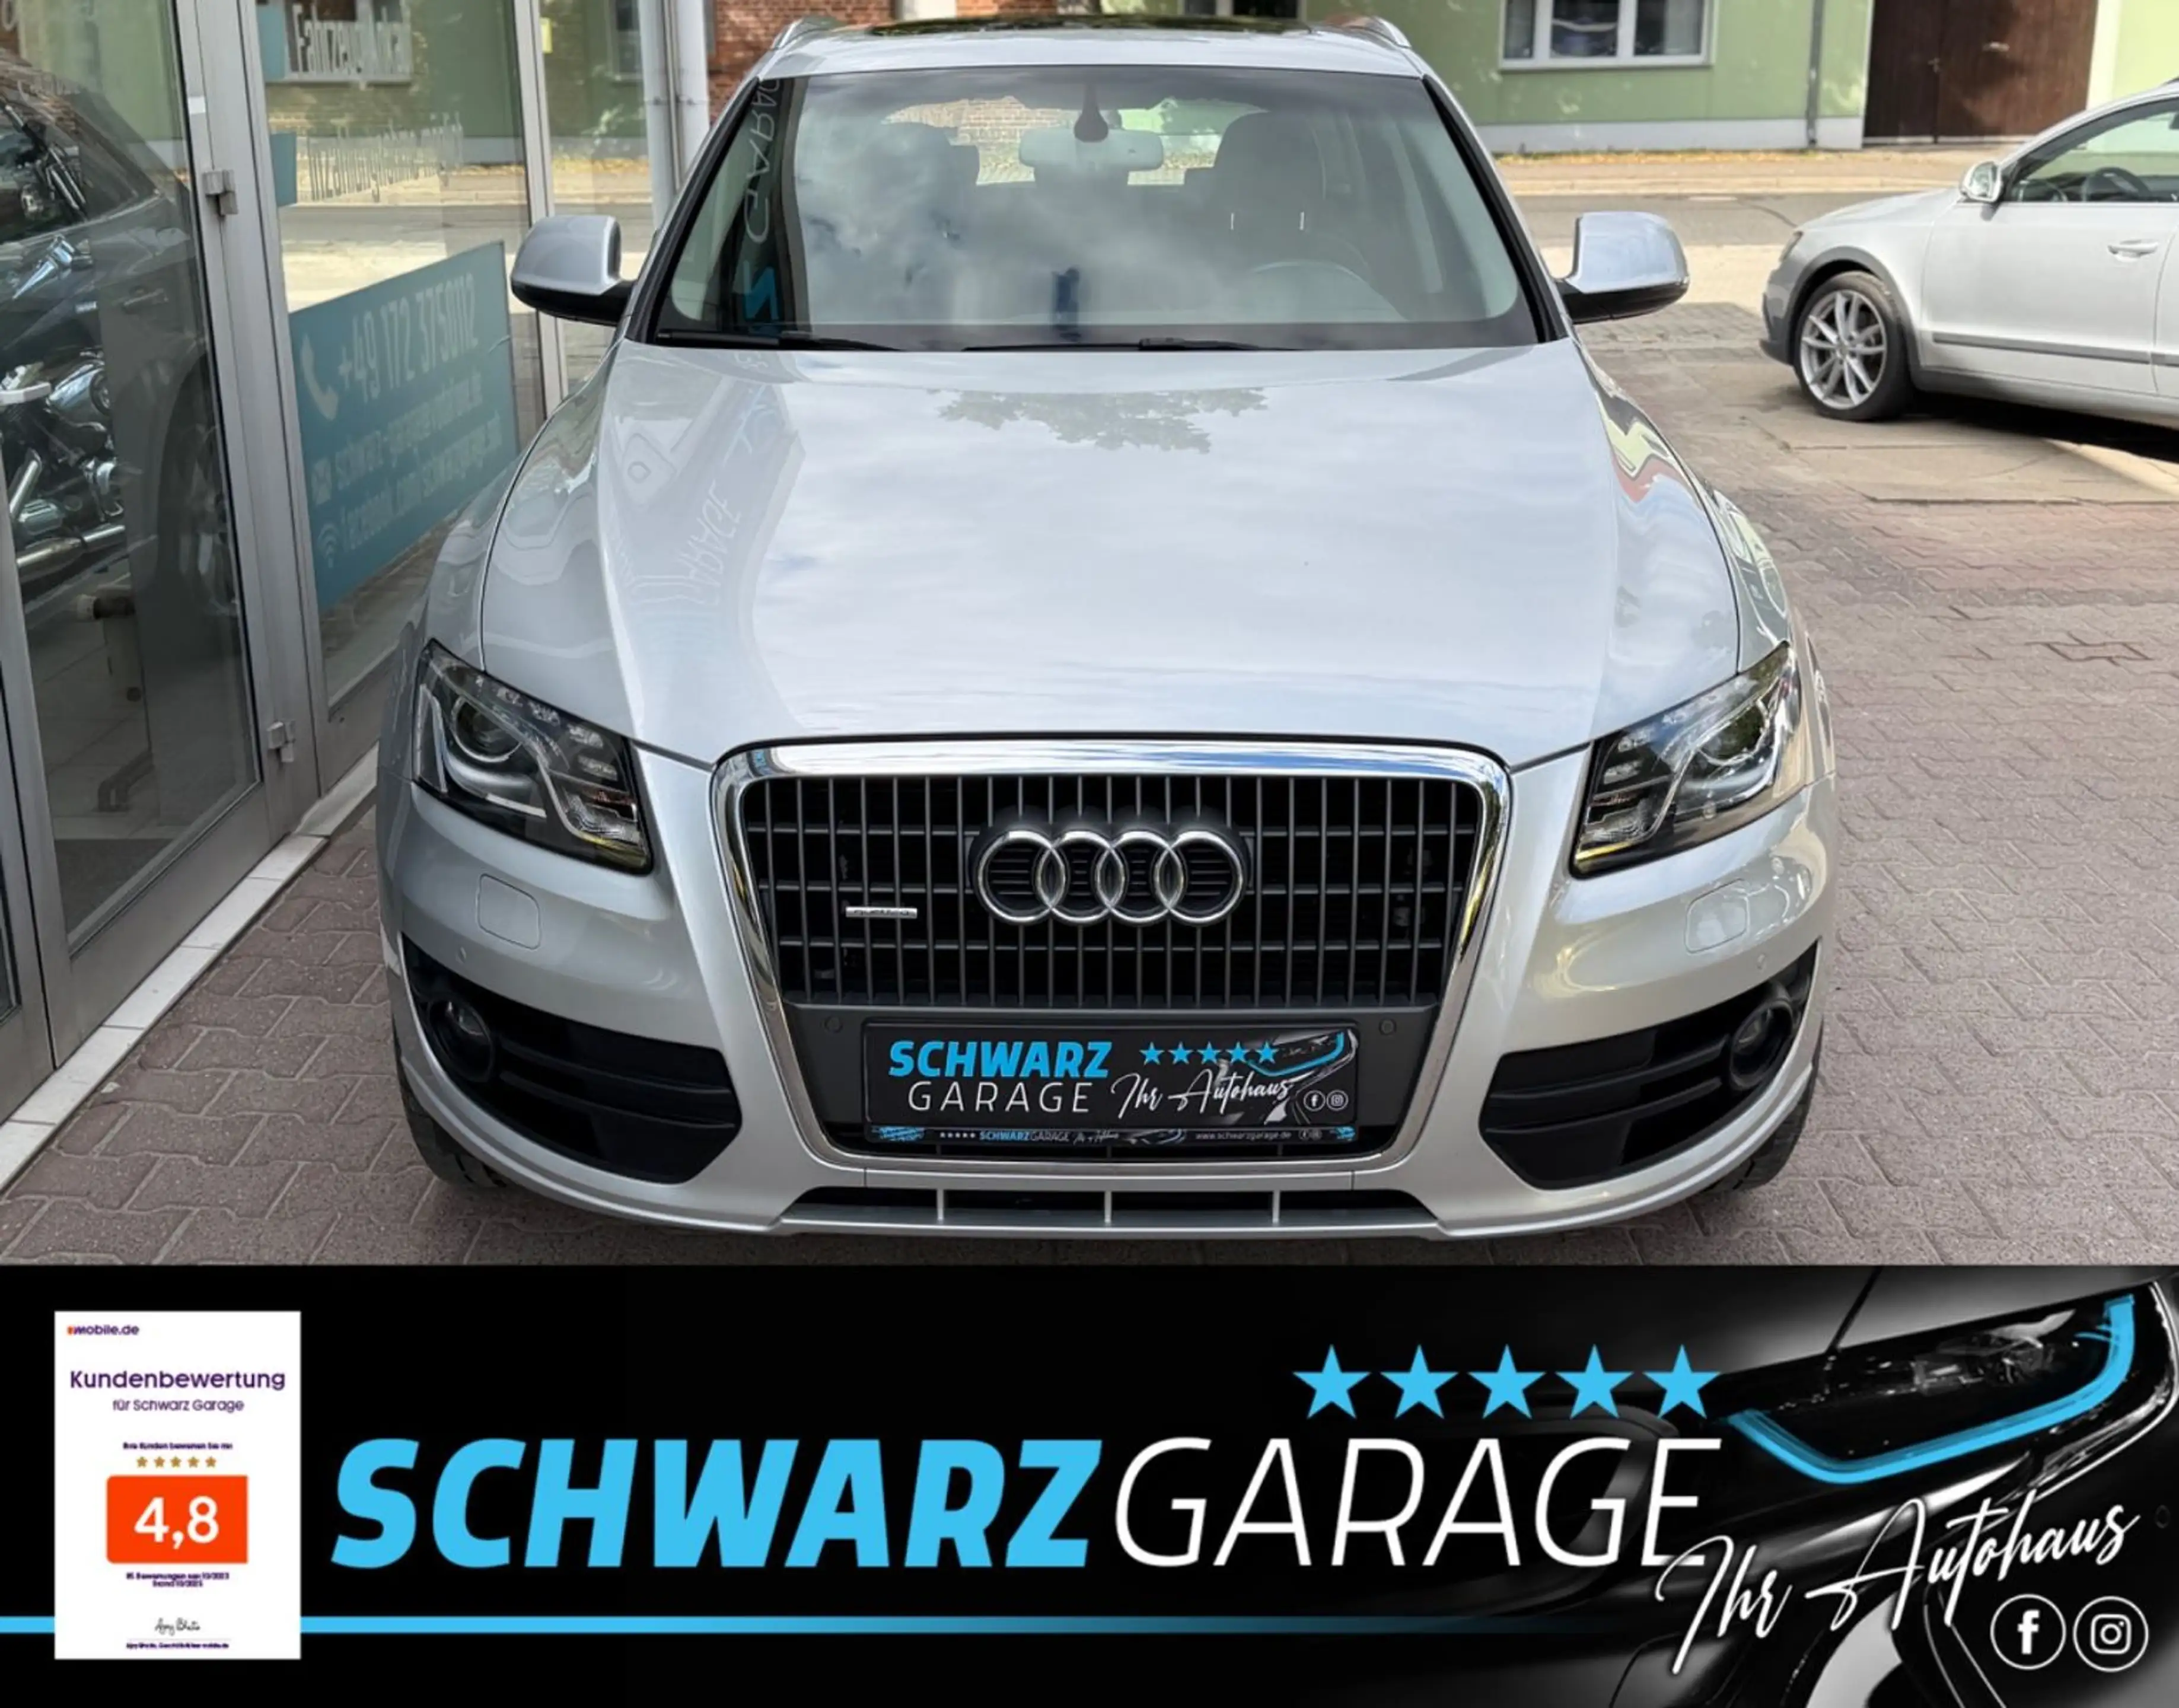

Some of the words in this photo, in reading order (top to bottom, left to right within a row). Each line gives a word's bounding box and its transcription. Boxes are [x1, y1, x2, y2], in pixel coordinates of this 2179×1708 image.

[337, 310, 381, 404] +49
[380, 296, 415, 390] 172
[888, 1040, 1113, 1078] SCHWARZ
[908, 1081, 1092, 1113] GARAGE
[1110, 1072, 1162, 1119] Ihr
[1168, 1068, 1294, 1114] Autohaus
